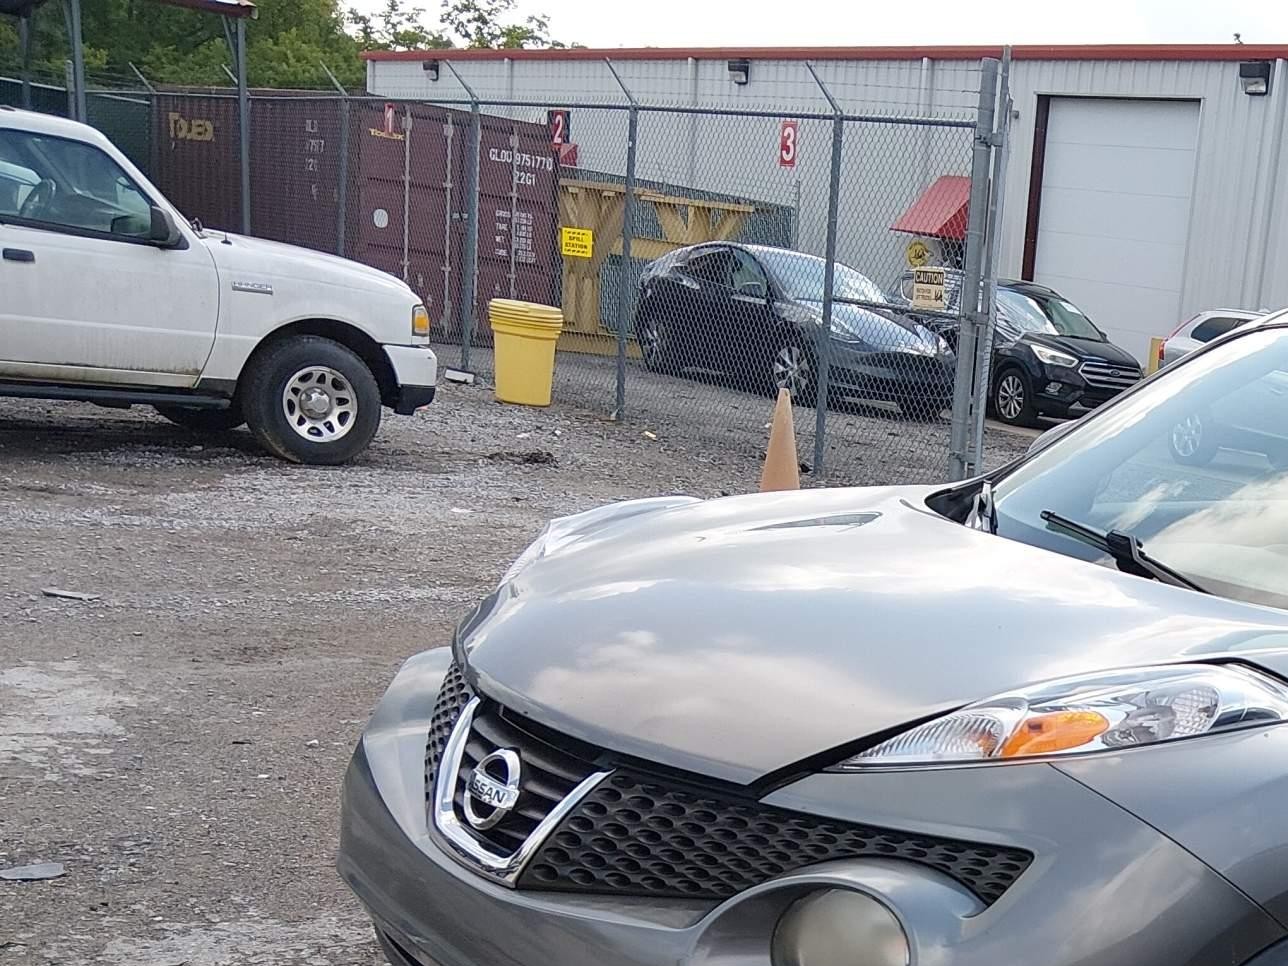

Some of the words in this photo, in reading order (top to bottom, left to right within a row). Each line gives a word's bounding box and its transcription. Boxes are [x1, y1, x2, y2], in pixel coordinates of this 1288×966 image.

[386, 107, 392, 132] 1
[553, 114, 563, 143] 2
[782, 126, 795, 161] 3
[564, 242, 588, 250] STATION
[915, 271, 944, 285] CAUTION
